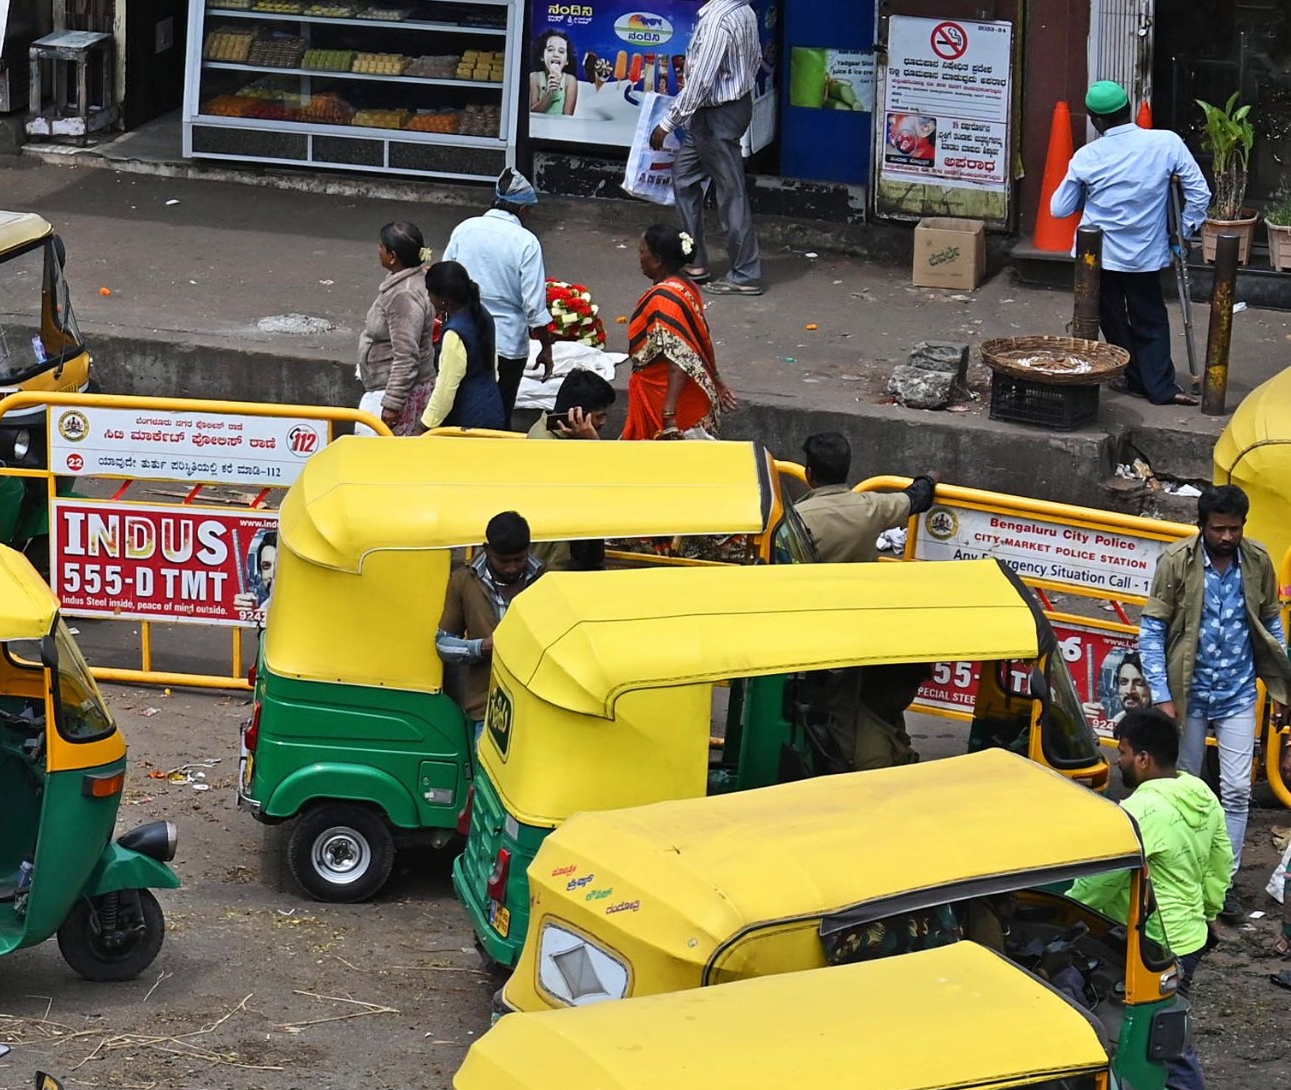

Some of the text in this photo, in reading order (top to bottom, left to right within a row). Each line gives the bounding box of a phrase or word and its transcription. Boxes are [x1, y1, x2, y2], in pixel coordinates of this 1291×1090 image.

[548, 3, 592, 16] ನಂದಿನಿ
[628, 32, 660, 42] ನಂದಿನಿ
[944, 156, 996, 173] ಅಪರಾಧ
[291, 432, 317, 453] 112
[67, 456, 85, 469] 22
[63, 511, 229, 567] INDUS
[989, 516, 1136, 551] Bengaluru City Police
[974, 532, 1148, 571] CITY MARKET POLICE STATION
[63, 562, 229, 603] 555-D TMT
[1050, 565, 1106, 586] Situation
[1108, 573, 1133, 590] Call
[62, 594, 86, 607] Indus
[86, 595, 108, 608] Steel
[137, 601, 163, 613] peace
[164, 601, 173, 612] of
[174, 602, 195, 614] mind
[917, 685, 977, 706] PECIAL STEE
